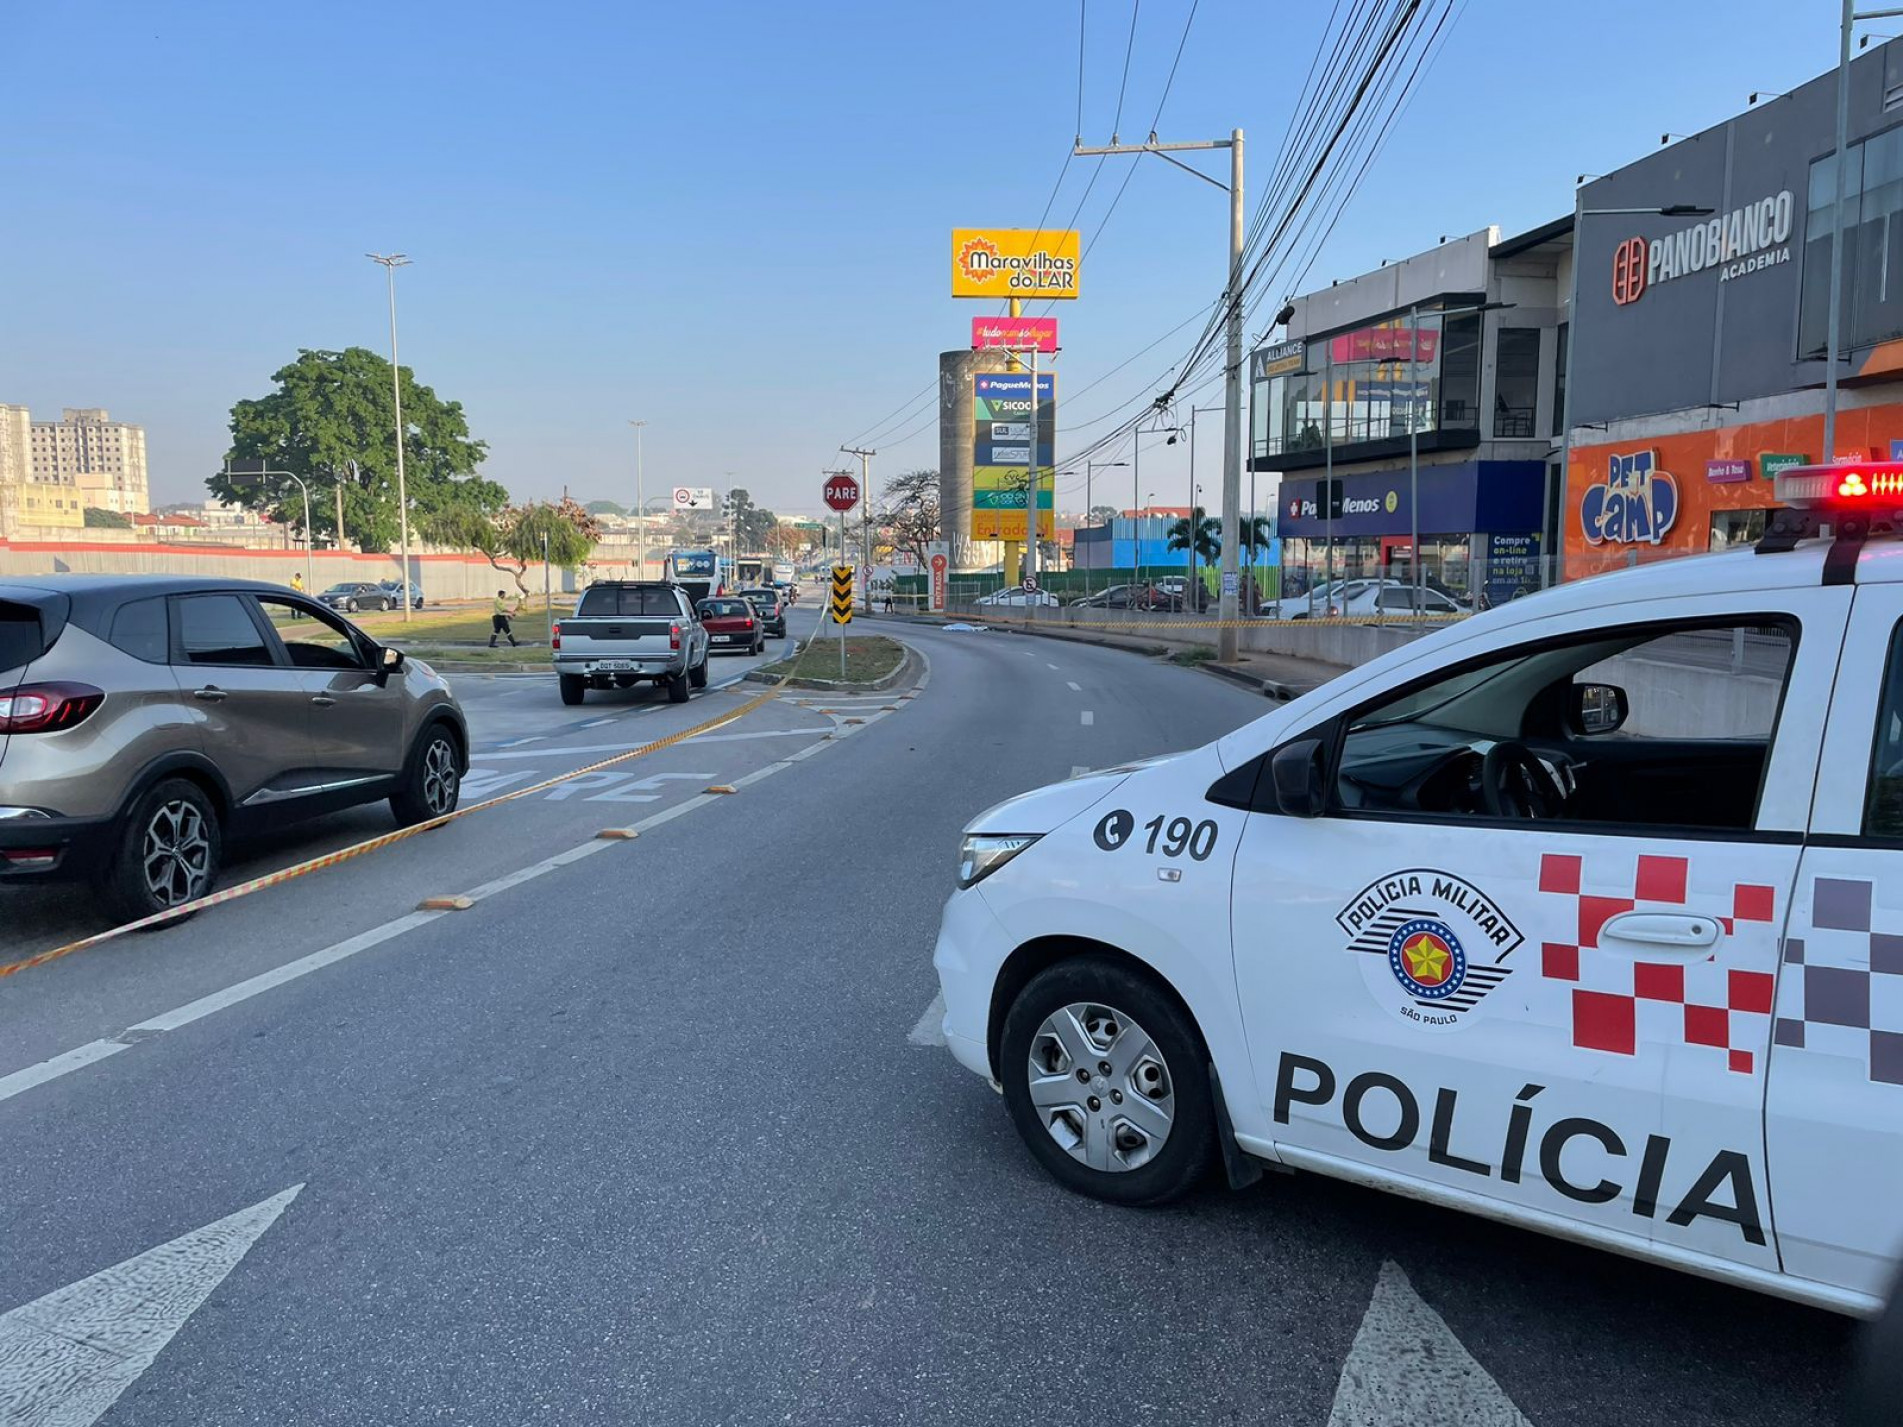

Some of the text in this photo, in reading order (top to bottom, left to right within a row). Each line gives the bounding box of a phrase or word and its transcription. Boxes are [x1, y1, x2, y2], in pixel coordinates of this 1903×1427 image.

[1647, 190, 1795, 286] PANOBIANCO
[969, 251, 1074, 270] Maravilhas
[1720, 247, 1790, 282] ACADEMIA
[1009, 272, 1074, 289] do LAR
[1267, 342, 1302, 361] ALLIANCE
[1002, 401, 1038, 410] SICOO
[1609, 452, 1652, 488] PET
[826, 486, 857, 499] PARE
[1494, 536, 1530, 546] Compre
[1143, 814, 1219, 862] 190
[1348, 876, 1512, 947] POLÍCIA MILITAR
[1399, 1005, 1458, 1026] SÃO PAULO
[1273, 1051, 1767, 1247] POLÍCIA
